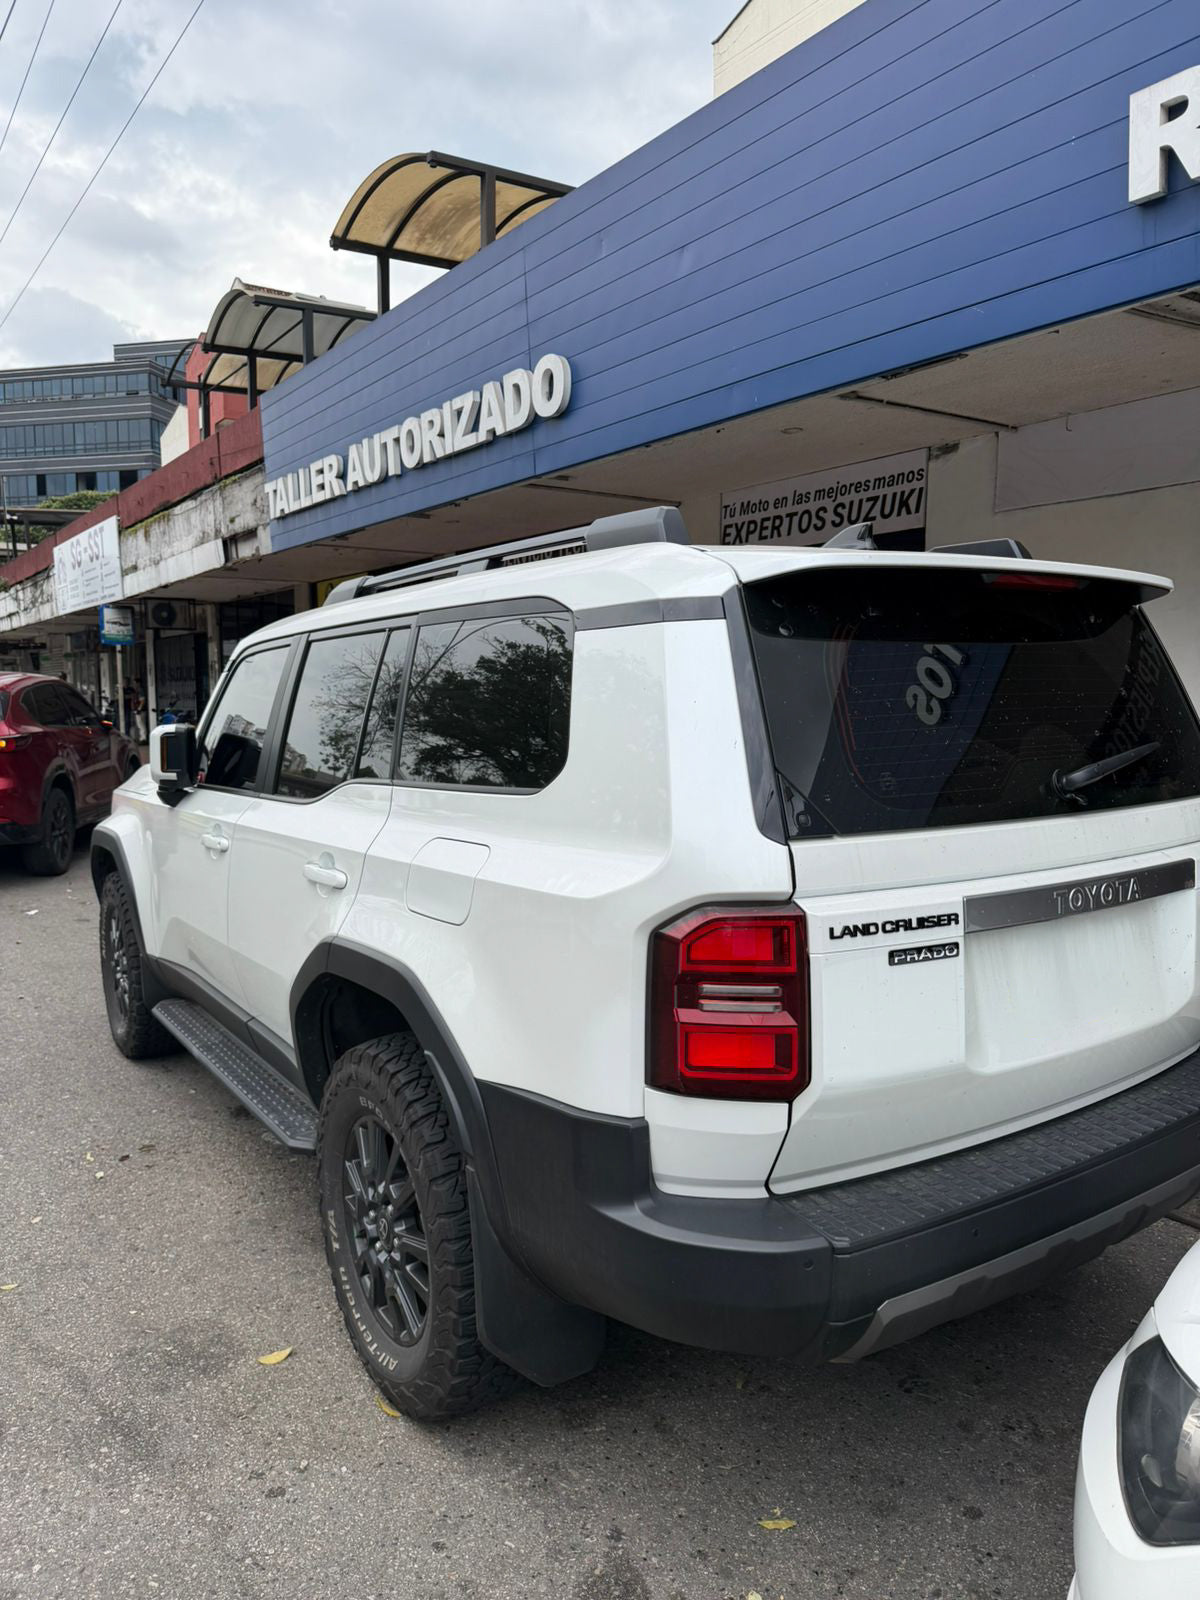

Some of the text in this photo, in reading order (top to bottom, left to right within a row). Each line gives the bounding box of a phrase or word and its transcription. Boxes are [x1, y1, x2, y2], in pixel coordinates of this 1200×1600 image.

[264, 353, 572, 519] TALLER AUTORIZADO
[722, 468, 925, 520] Tú Moto en las mejores manos
[722, 486, 925, 546] EXPERTOS SUZUKI
[1053, 877, 1141, 915] TOYOTA
[829, 912, 960, 940] LAND CRUISER
[892, 944, 958, 964] PRADO
